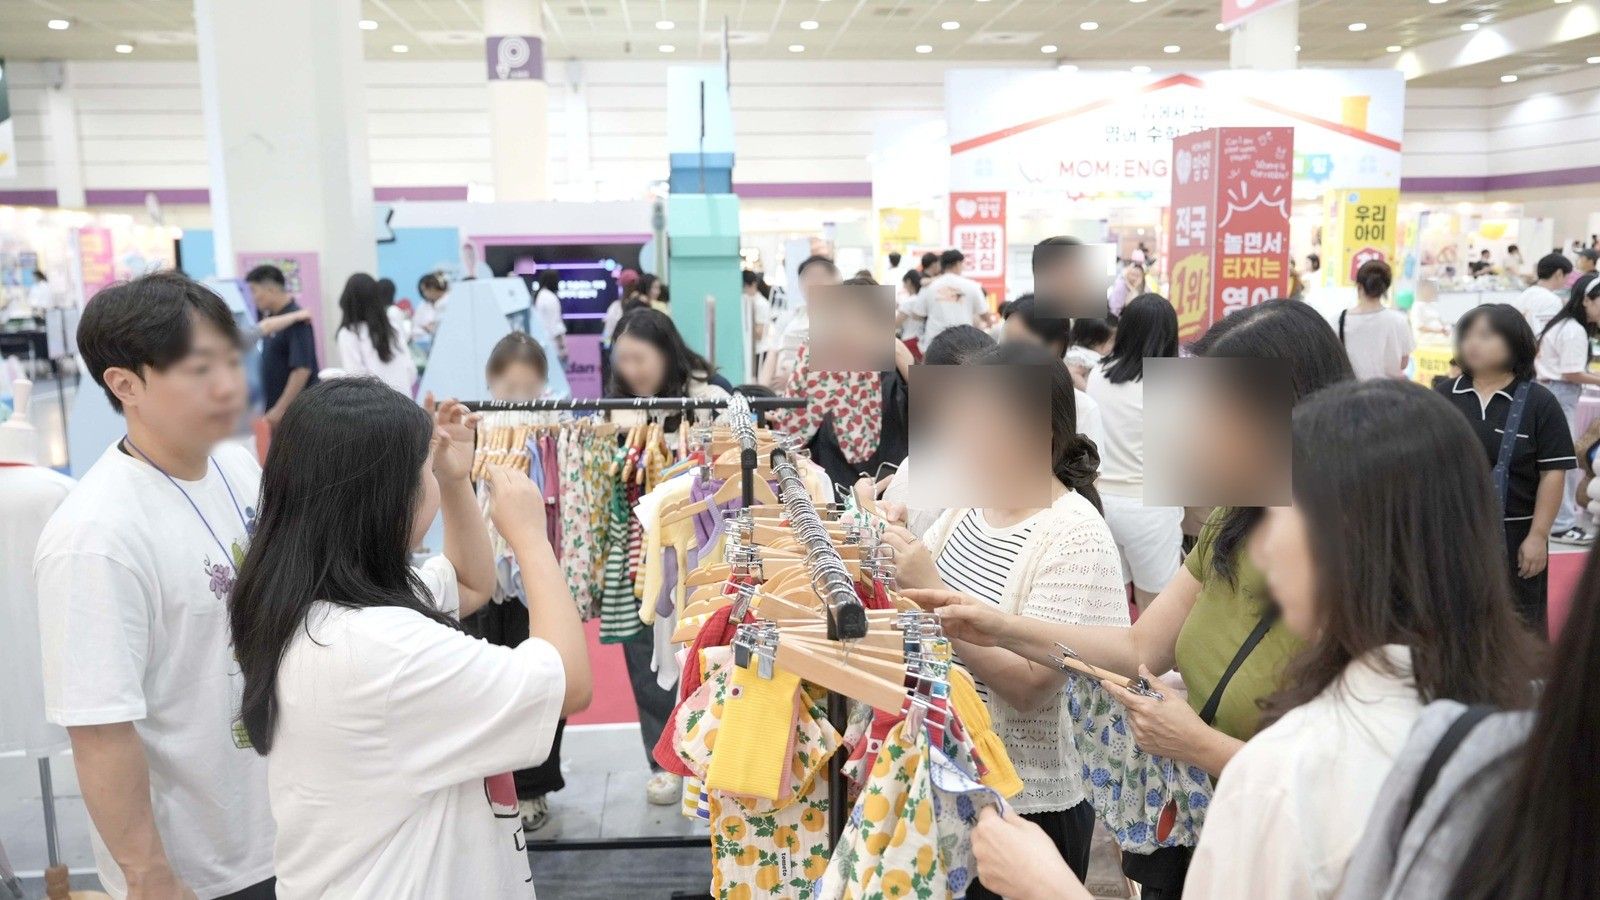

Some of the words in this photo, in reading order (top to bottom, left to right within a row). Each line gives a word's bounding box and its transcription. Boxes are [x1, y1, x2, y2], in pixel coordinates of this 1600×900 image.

[1356, 205, 1386, 222] 우리
[1175, 205, 1207, 247] 전국
[1355, 225, 1385, 241] 아이
[961, 231, 996, 251] 발화
[1224, 231, 1282, 254] 놀면서
[1222, 256, 1281, 279] 터지는
[1176, 264, 1204, 317] 1위
